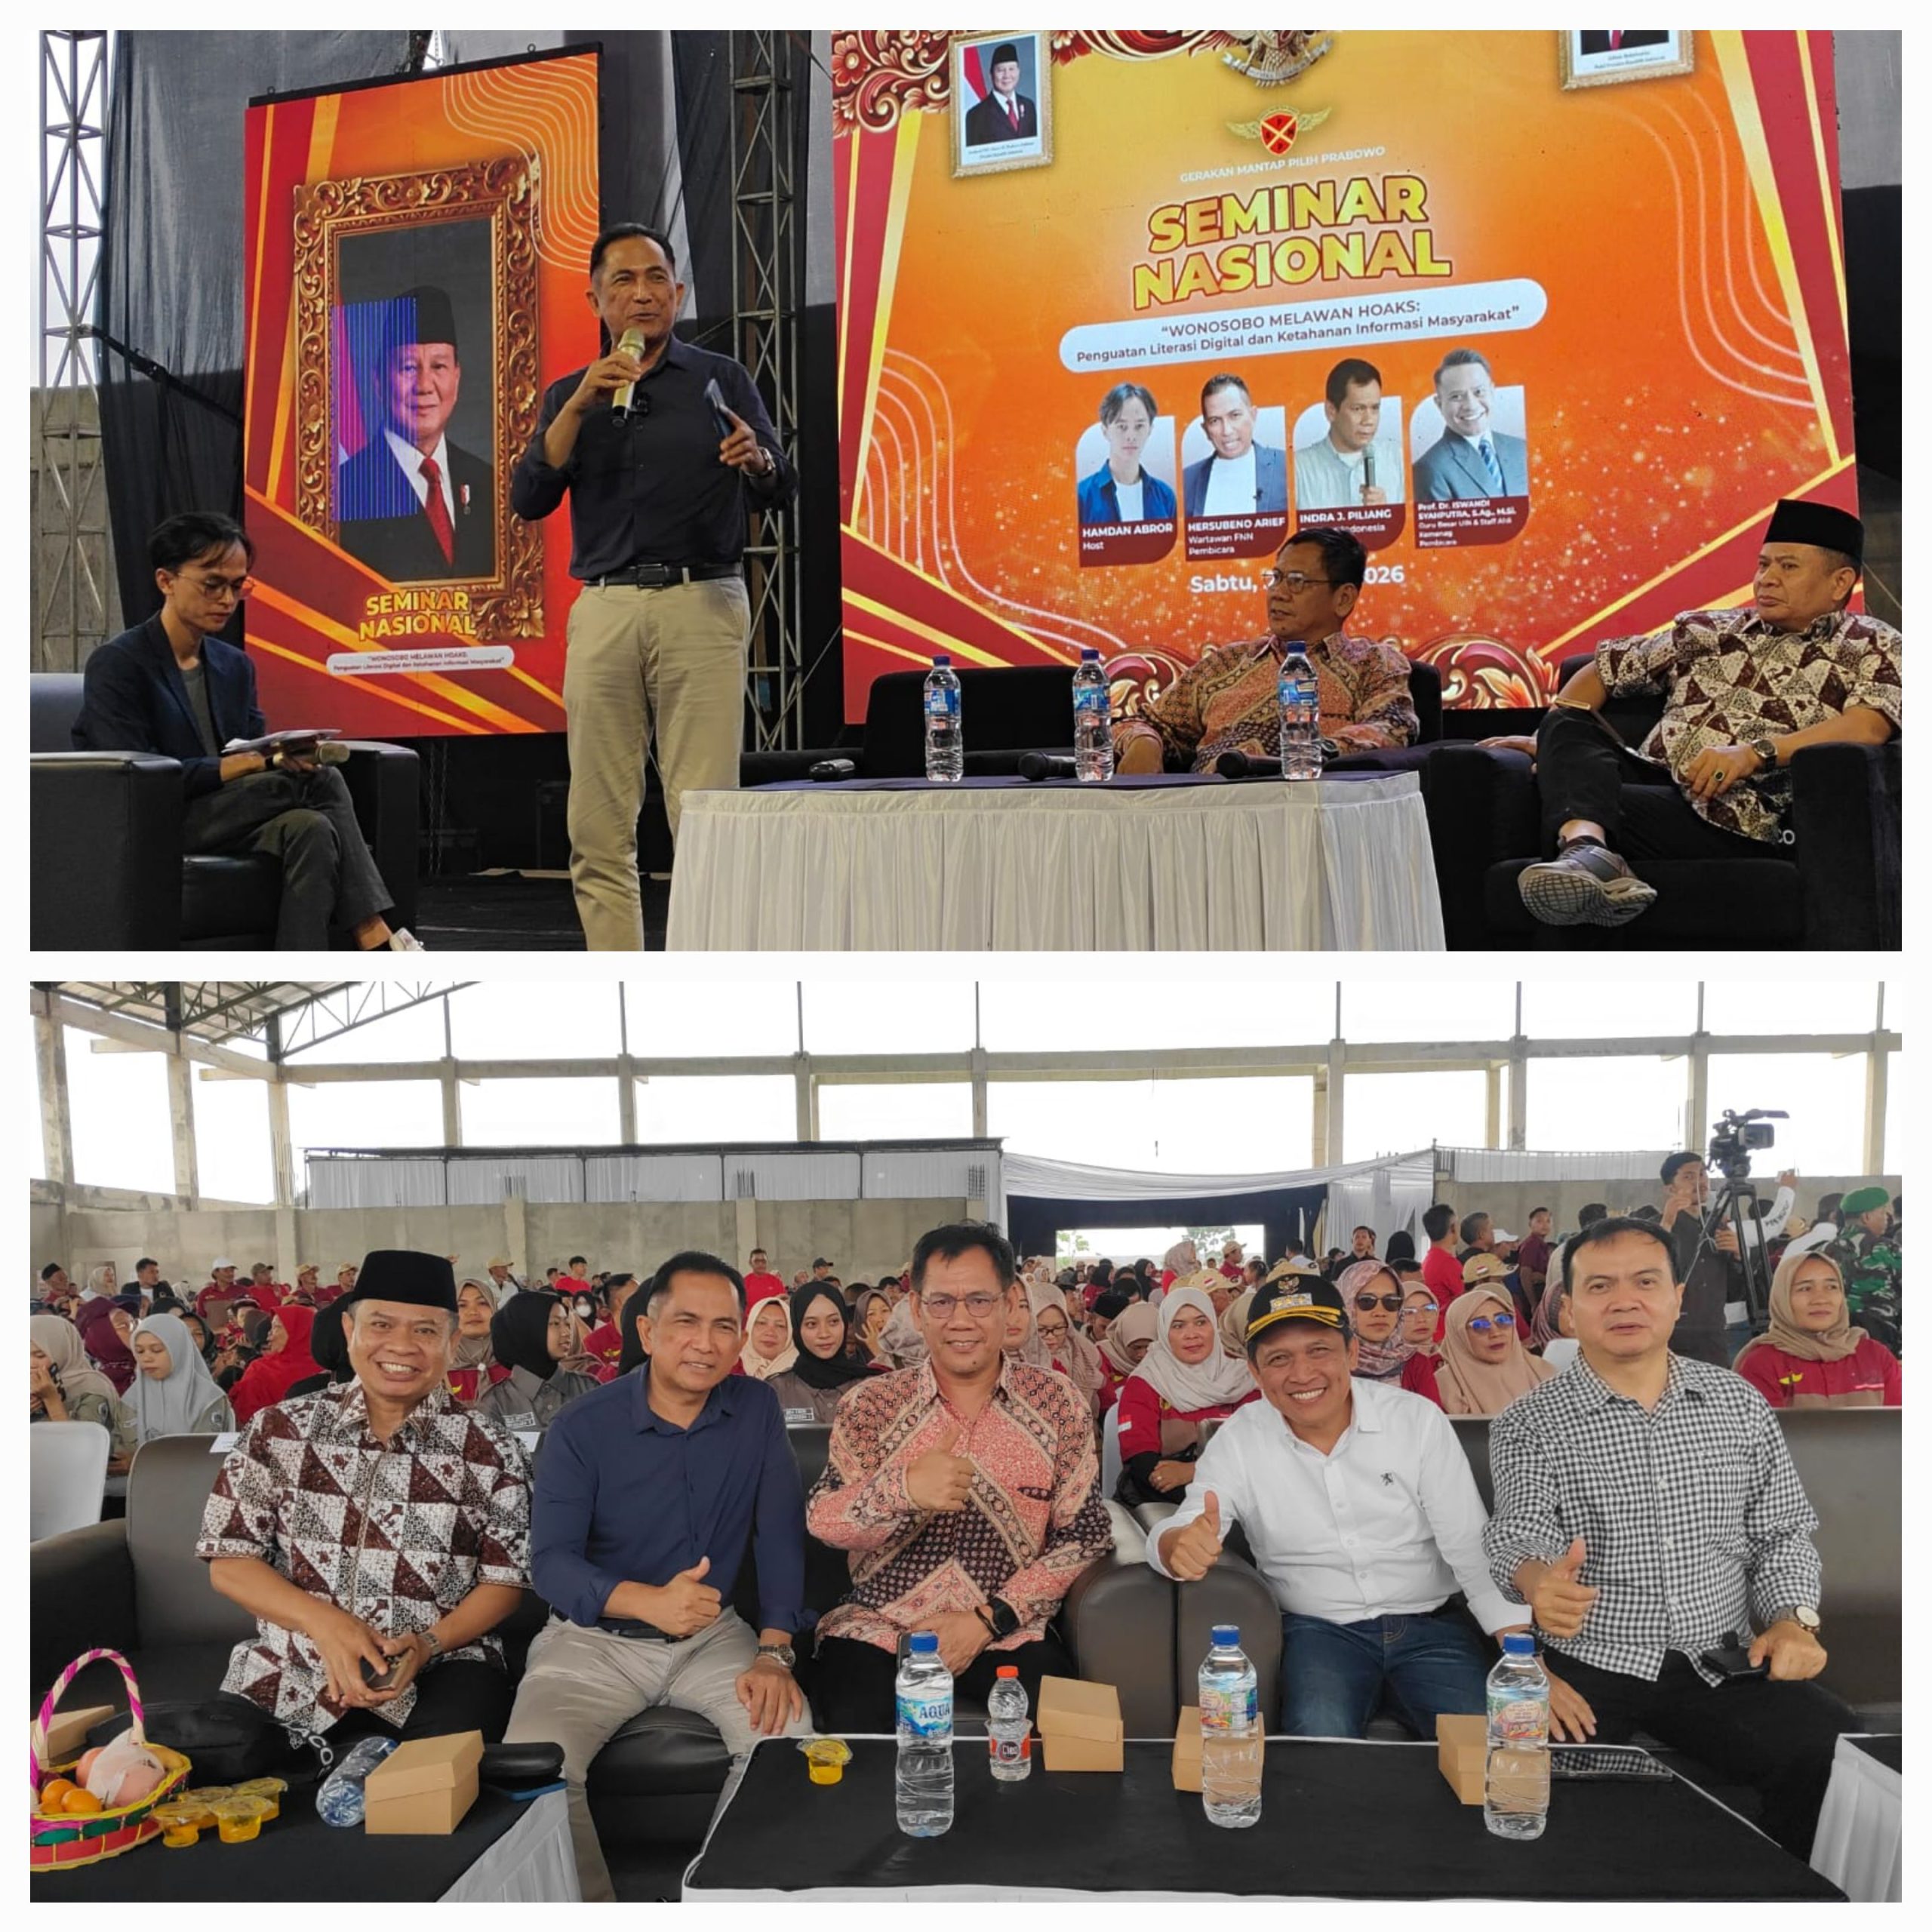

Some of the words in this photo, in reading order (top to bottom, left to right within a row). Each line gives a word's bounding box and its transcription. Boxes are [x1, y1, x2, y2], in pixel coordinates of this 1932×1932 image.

[1180, 167, 1234, 182] GERAKAN
[1237, 159, 1285, 175] MANTAP
[1288, 155, 1318, 168] PILIH
[1321, 146, 1386, 163] PRABOWO
[1149, 175, 1428, 253] SEMINAR
[1133, 229, 1452, 309] NASIONAL
[1269, 307, 1353, 327] MELAWAN
[1358, 300, 1420, 318] HOAKS:
[1077, 348, 1146, 362] Penguatan
[1150, 339, 1196, 355] Literasi
[1201, 333, 1244, 351] Digital
[1247, 331, 1273, 346] dan
[1278, 324, 1352, 341] Ketahanan
[1356, 317, 1423, 334] Informasi
[1418, 502, 1437, 511] Prof.
[1438, 502, 1451, 510] Dr.
[1452, 499, 1491, 509] ISWANDI
[1188, 518, 1253, 532] HERSUBENO
[1254, 516, 1286, 528] ARIEF
[1300, 512, 1335, 524] INDRA
[1337, 511, 1346, 522] J.
[1348, 509, 1392, 521] PILIANG
[1082, 526, 1131, 538] HAMDAN
[1134, 523, 1174, 535] ABROR
[1189, 534, 1233, 544] Wartawan
[1234, 531, 1254, 542] FNN
[1082, 540, 1105, 551] Host
[1189, 545, 1235, 555] Pembicara
[1190, 573, 1257, 593] Sabtu,
[1364, 565, 1405, 585] 026
[366, 590, 469, 616] SEMINAR
[358, 614, 477, 641] NASIONAL
[919, 1703, 950, 1720] AQUA
